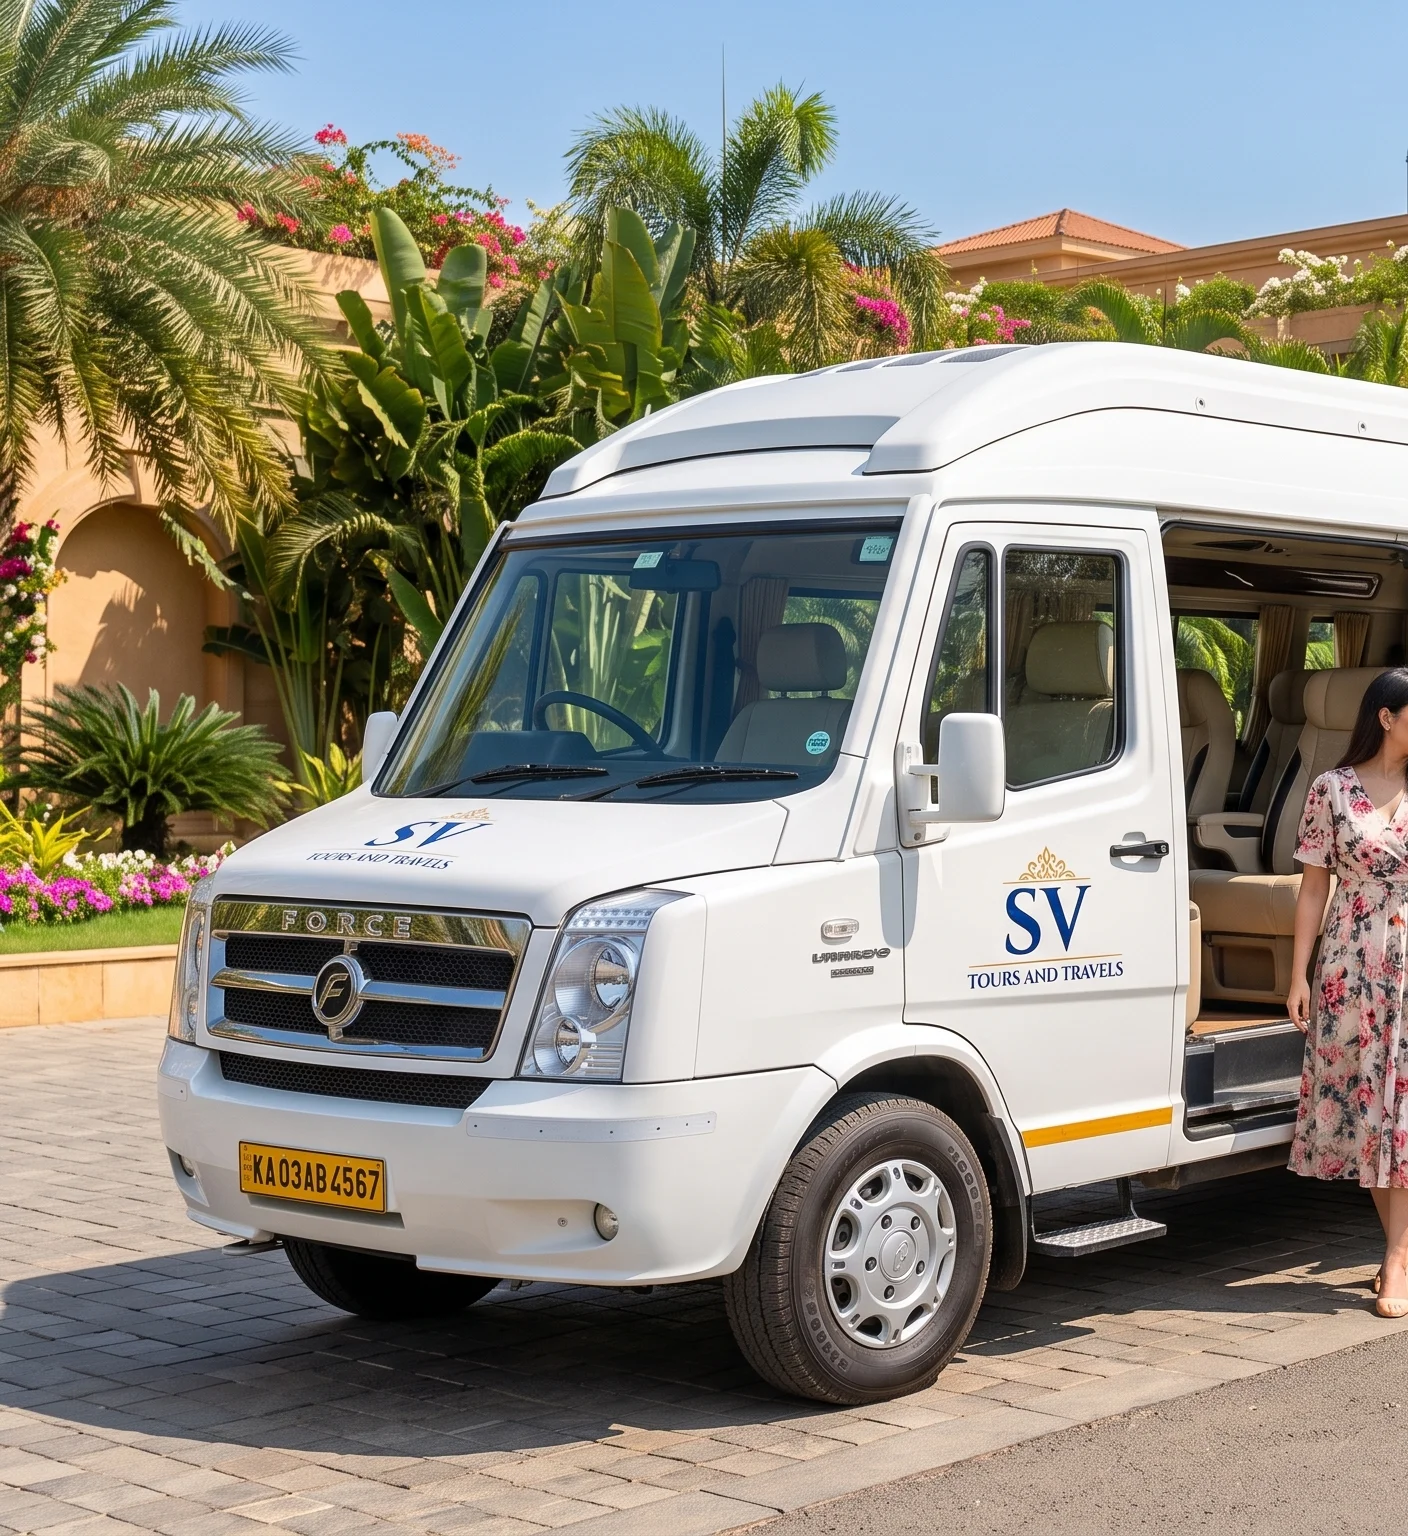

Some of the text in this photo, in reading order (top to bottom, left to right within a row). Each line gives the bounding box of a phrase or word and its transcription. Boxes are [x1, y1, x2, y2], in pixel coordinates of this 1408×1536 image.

[364, 821, 494, 849] SV
[388, 854, 454, 870] TRAVELS
[281, 910, 412, 939] FORCE
[1004, 885, 1092, 956] SV
[967, 961, 1124, 990] TOURS AND TRAVELS
[253, 1154, 380, 1201] KA03AB4567
